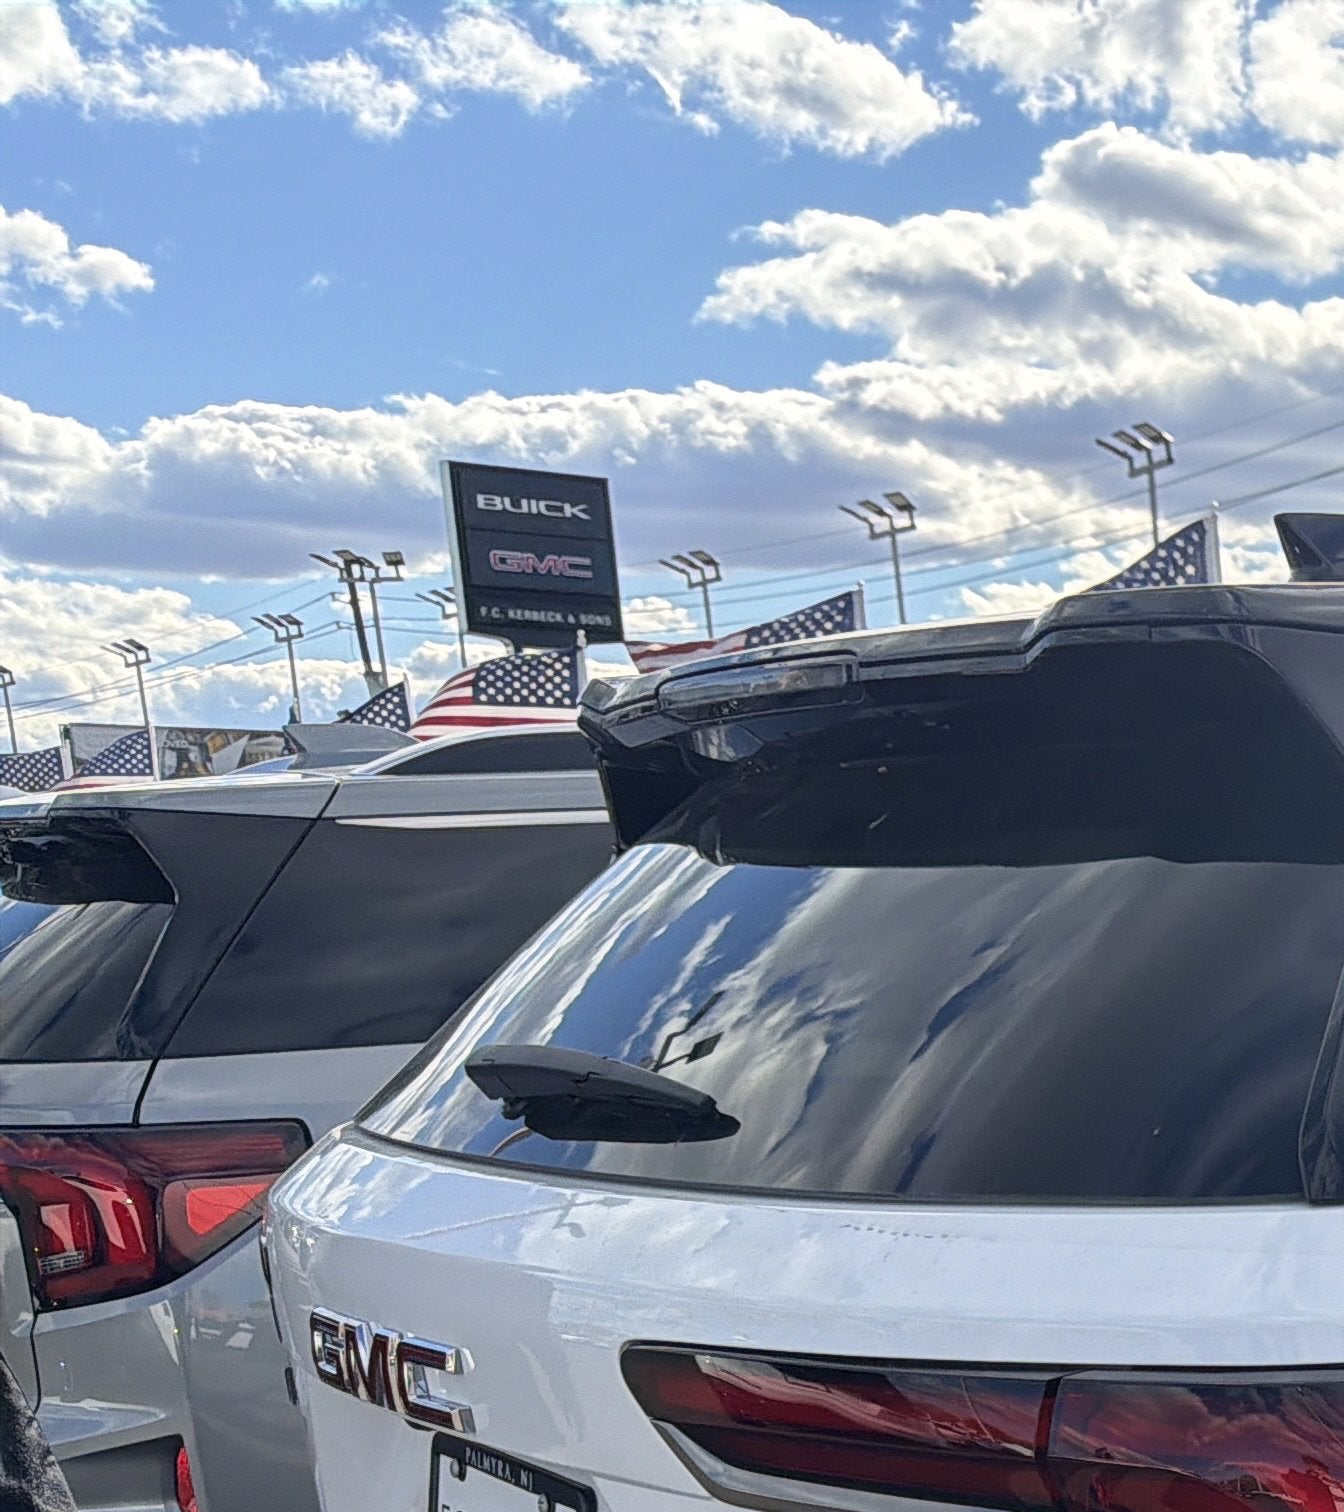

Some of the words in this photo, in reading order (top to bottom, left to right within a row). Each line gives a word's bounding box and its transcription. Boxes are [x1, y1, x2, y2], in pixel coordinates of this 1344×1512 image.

[476, 493, 591, 521] BUICK
[489, 549, 593, 579] GMC
[508, 608, 565, 624] KERBECK
[579, 614, 612, 627] SONS
[310, 1306, 476, 1433] GMC
